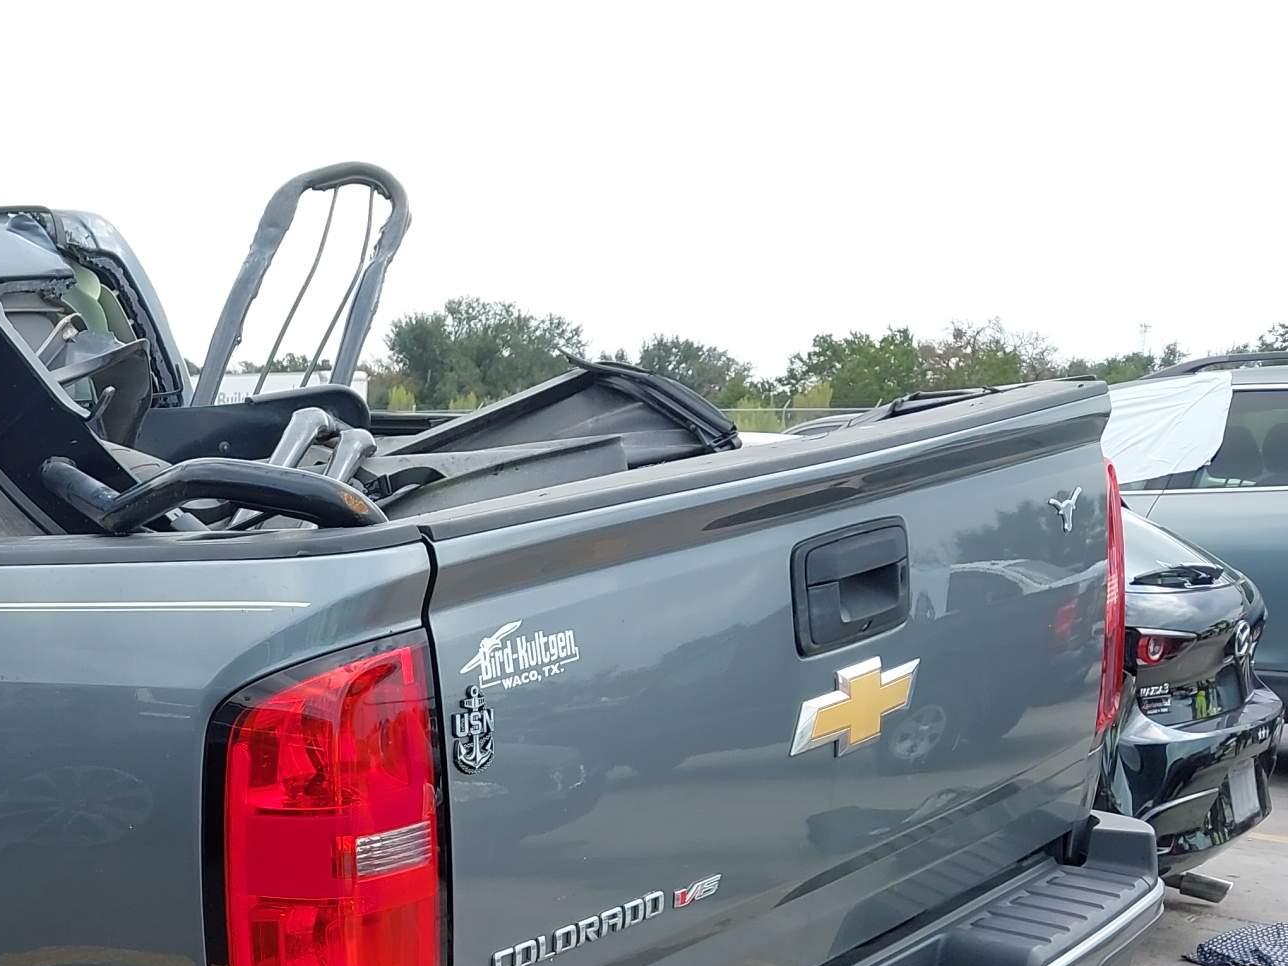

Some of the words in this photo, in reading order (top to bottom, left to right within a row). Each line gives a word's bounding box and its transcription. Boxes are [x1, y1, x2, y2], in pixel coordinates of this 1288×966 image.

[479, 629, 577, 681] Bird-Kultgen
[501, 670, 542, 690] WACO,
[542, 662, 565, 678] TX.
[672, 873, 722, 909] V6
